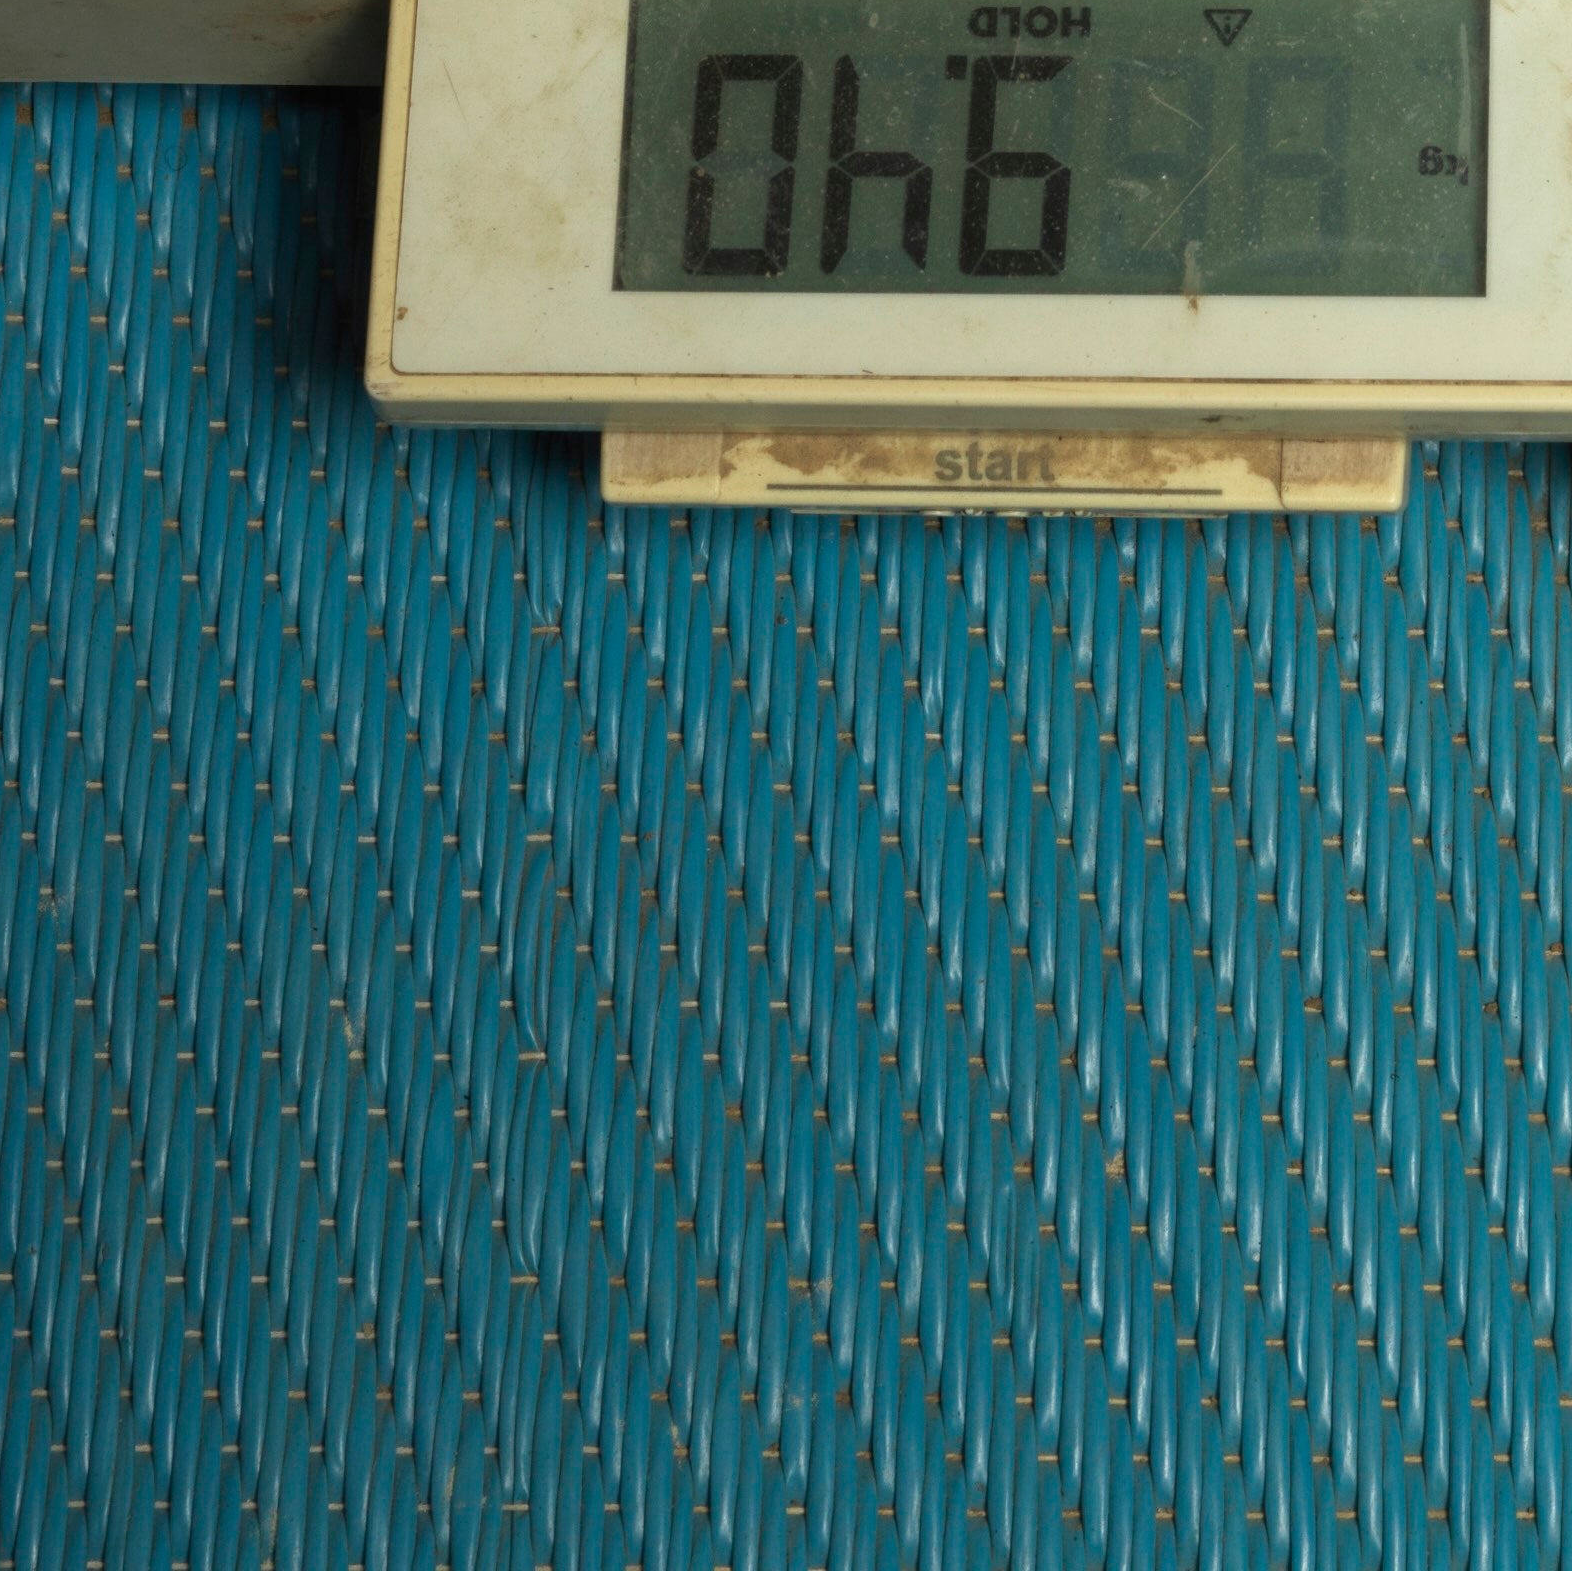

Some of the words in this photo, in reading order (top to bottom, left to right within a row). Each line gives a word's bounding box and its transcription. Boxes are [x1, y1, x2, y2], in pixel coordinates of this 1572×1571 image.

[967, 5, 1092, 39] HOLD
[682, 53, 1074, 278] 9.40
[1418, 145, 1470, 187] kg
[933, 441, 1057, 485] start
